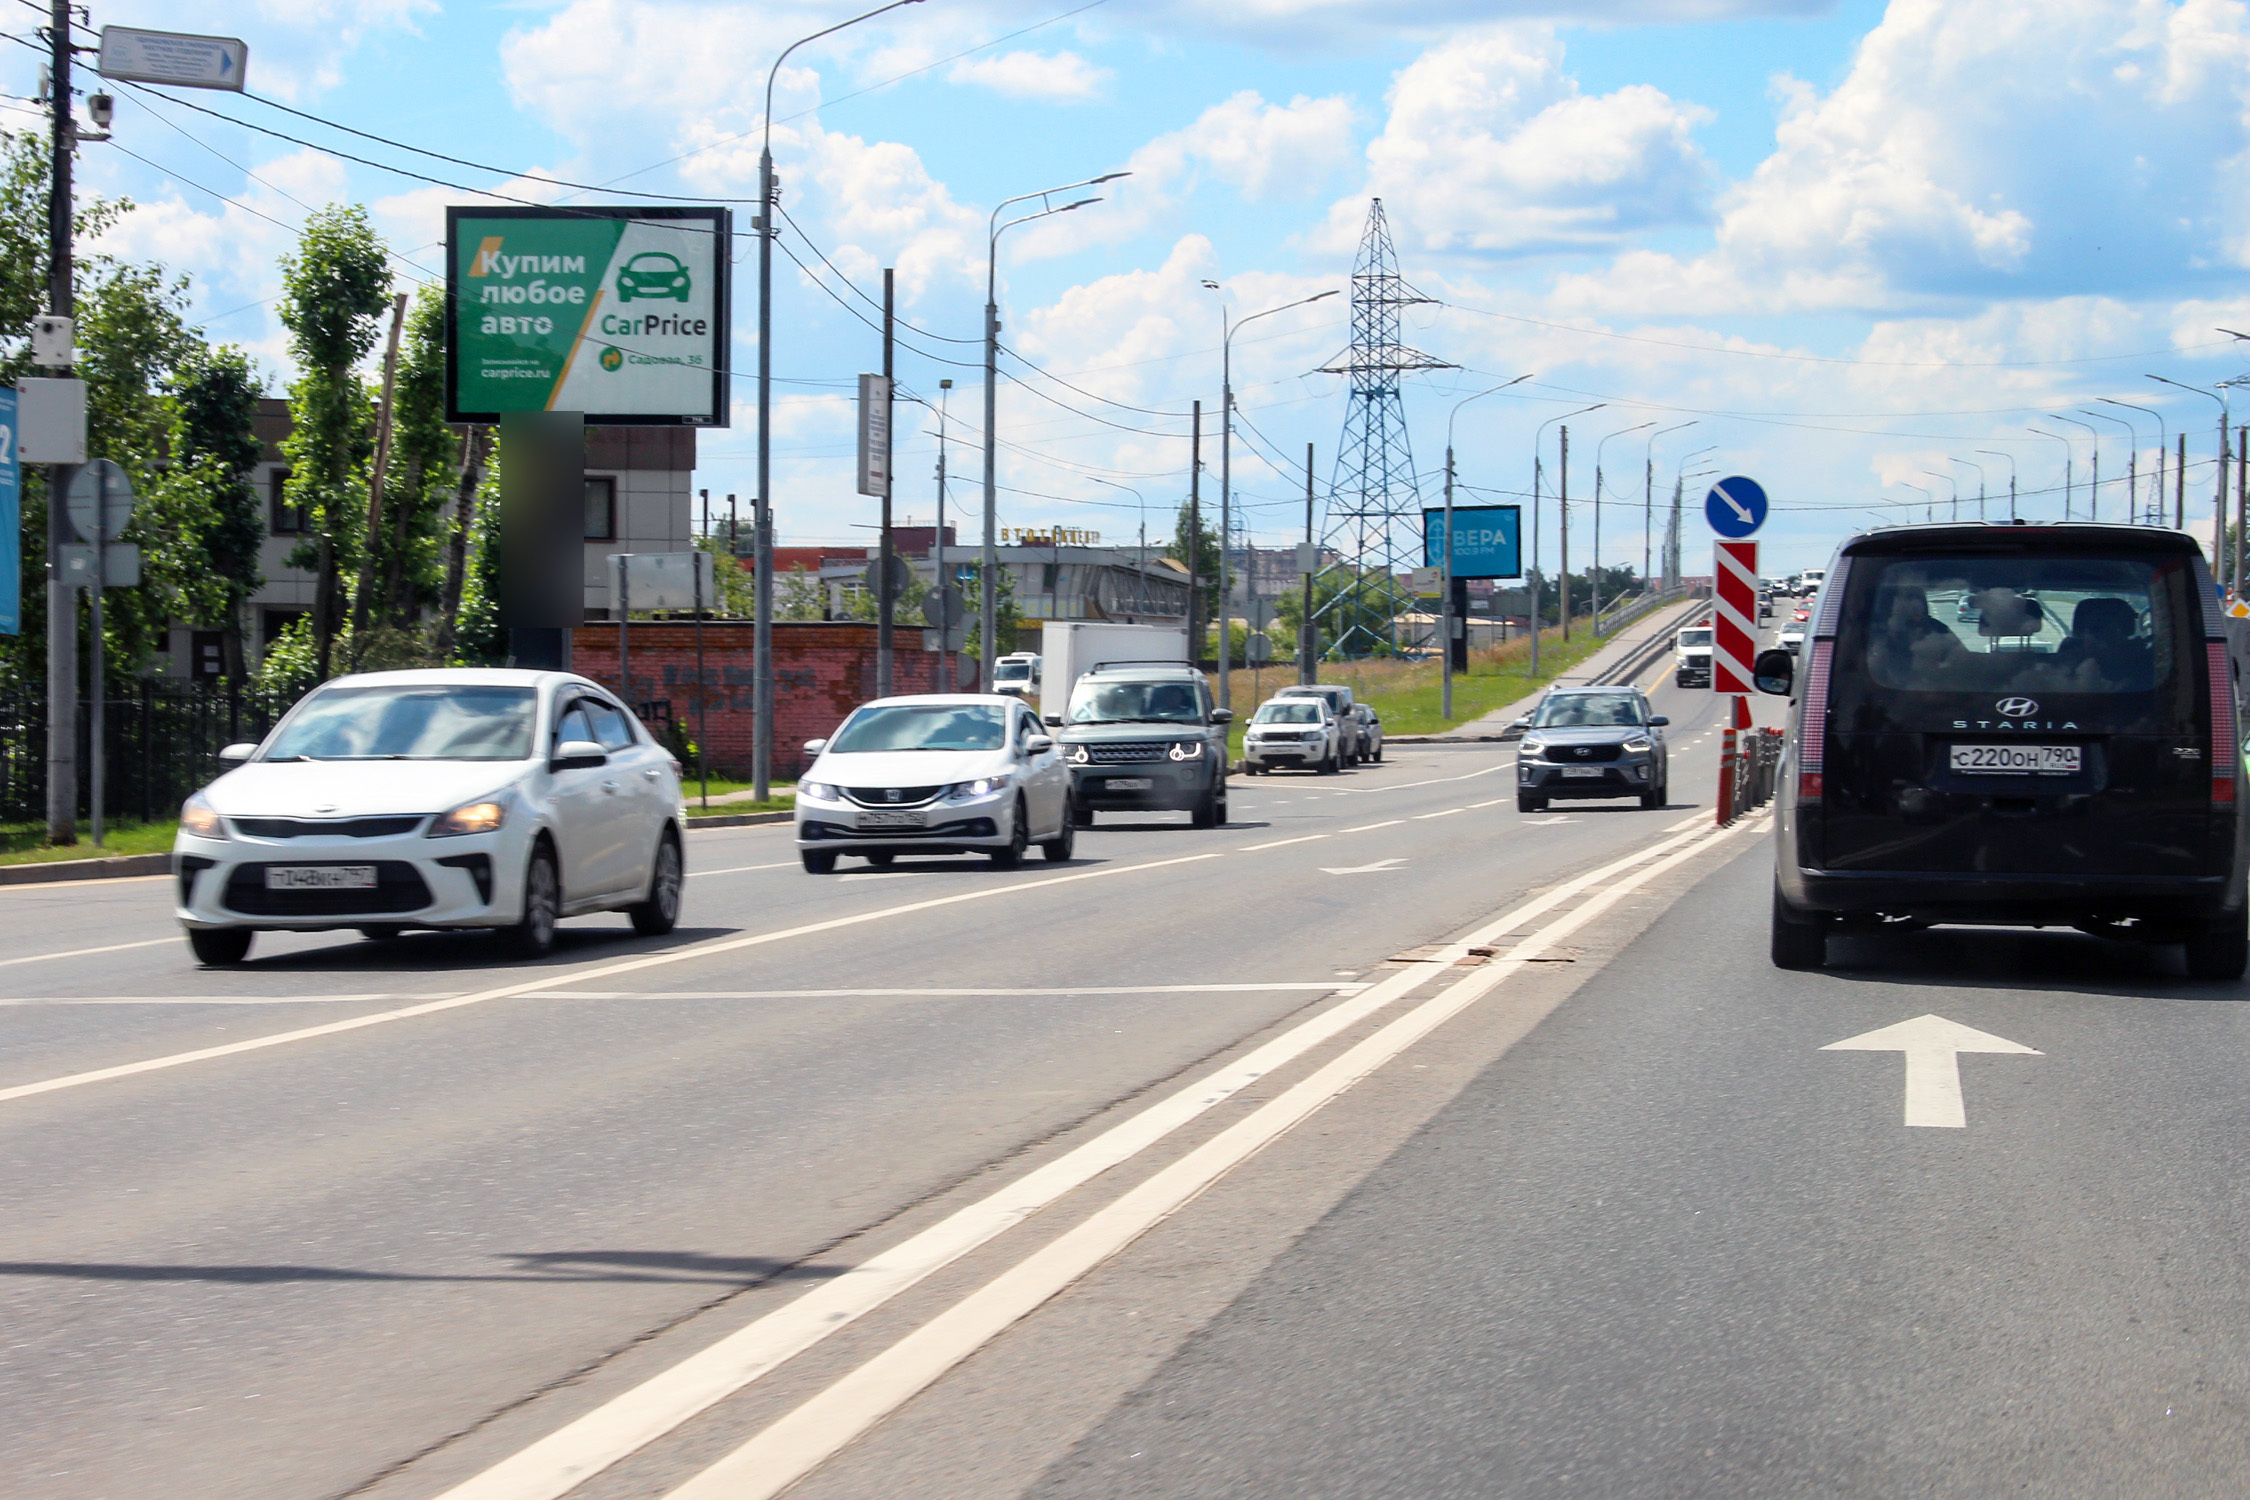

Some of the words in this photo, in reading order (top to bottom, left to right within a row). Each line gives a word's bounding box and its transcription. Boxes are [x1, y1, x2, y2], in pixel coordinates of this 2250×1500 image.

[481, 250, 585, 279] Купим
[480, 280, 586, 304] любое
[481, 315, 553, 335] авто
[602, 313, 707, 336] CarPrice
[481, 367, 551, 380] carprice.ru
[1453, 529, 1507, 546] ВЕРА
[1952, 720, 2079, 729] STARIA
[2042, 748, 2075, 762] 790
